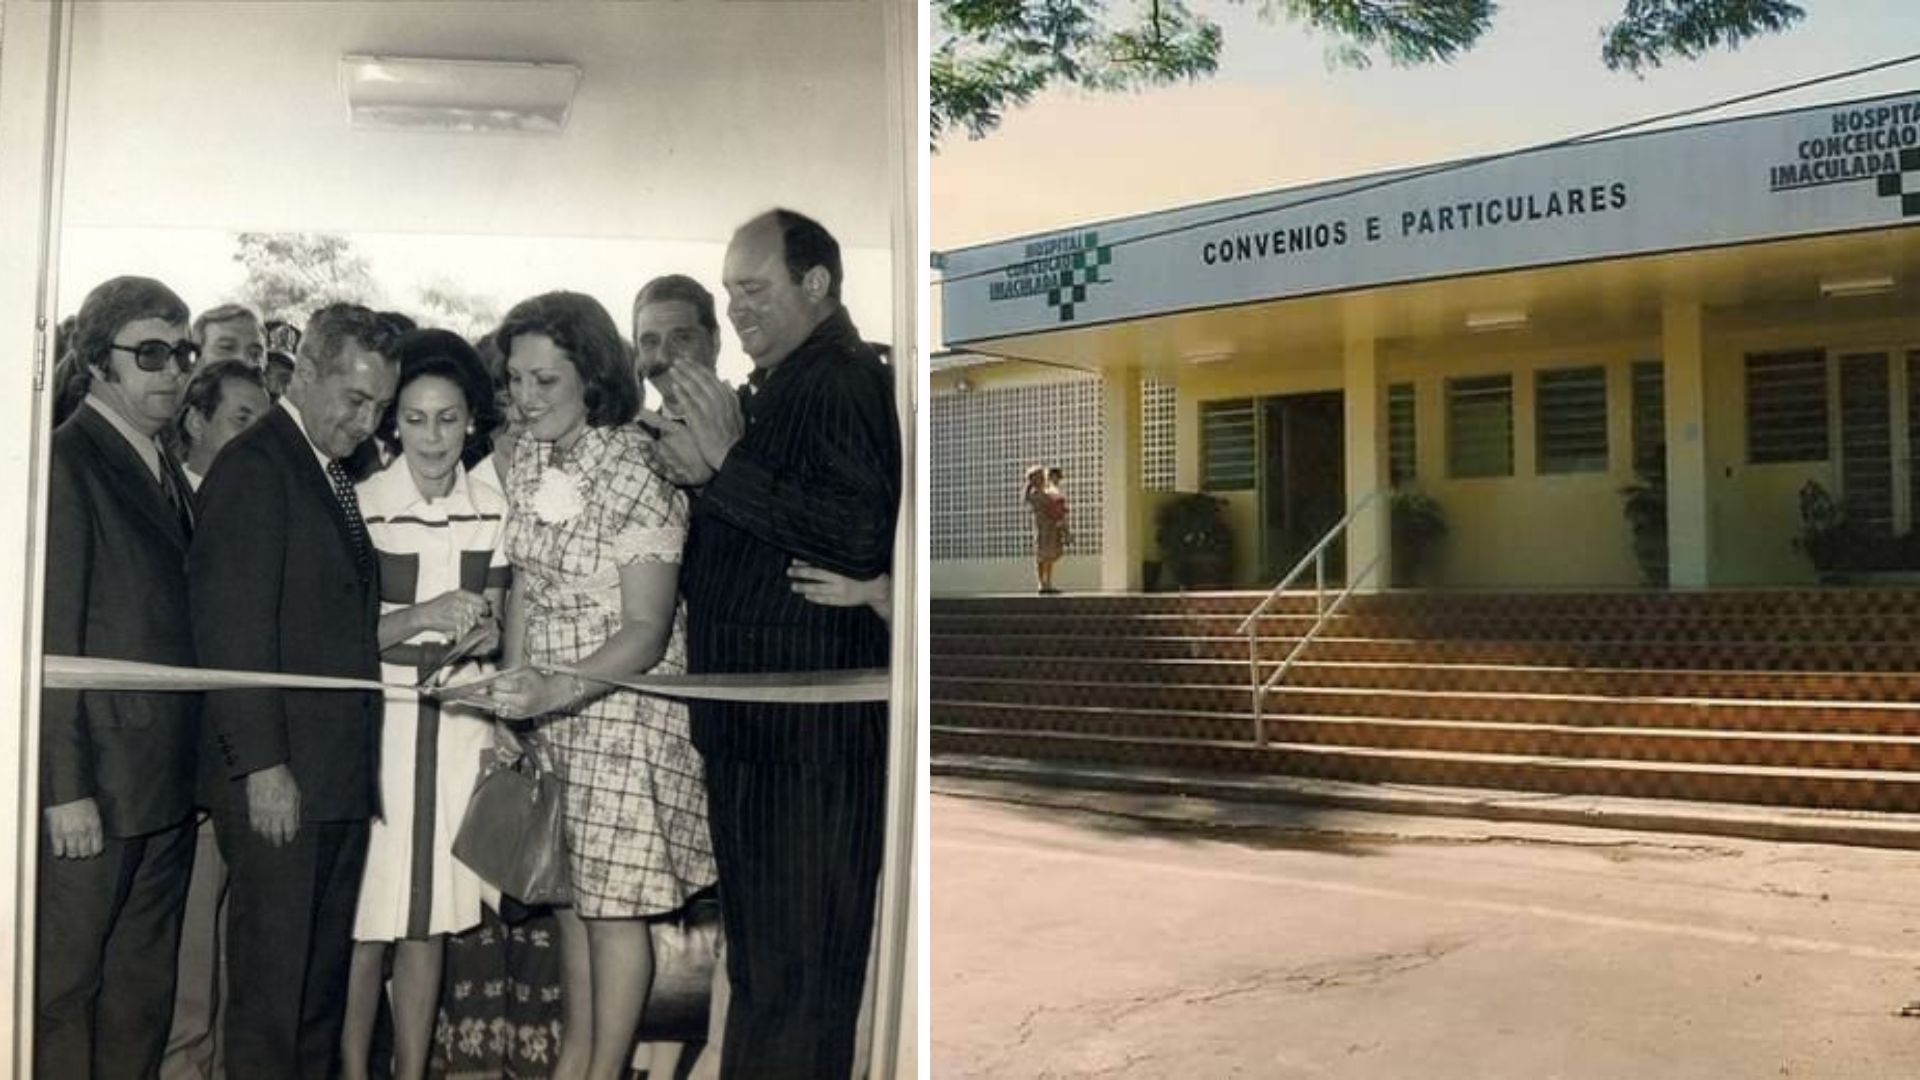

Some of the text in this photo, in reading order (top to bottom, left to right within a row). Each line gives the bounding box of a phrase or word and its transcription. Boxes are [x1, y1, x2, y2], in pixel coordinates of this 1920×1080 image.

[1769, 151, 1897, 187] IMACULADA
[1203, 182, 1627, 265] CONVENIOS E PARTICULARES
